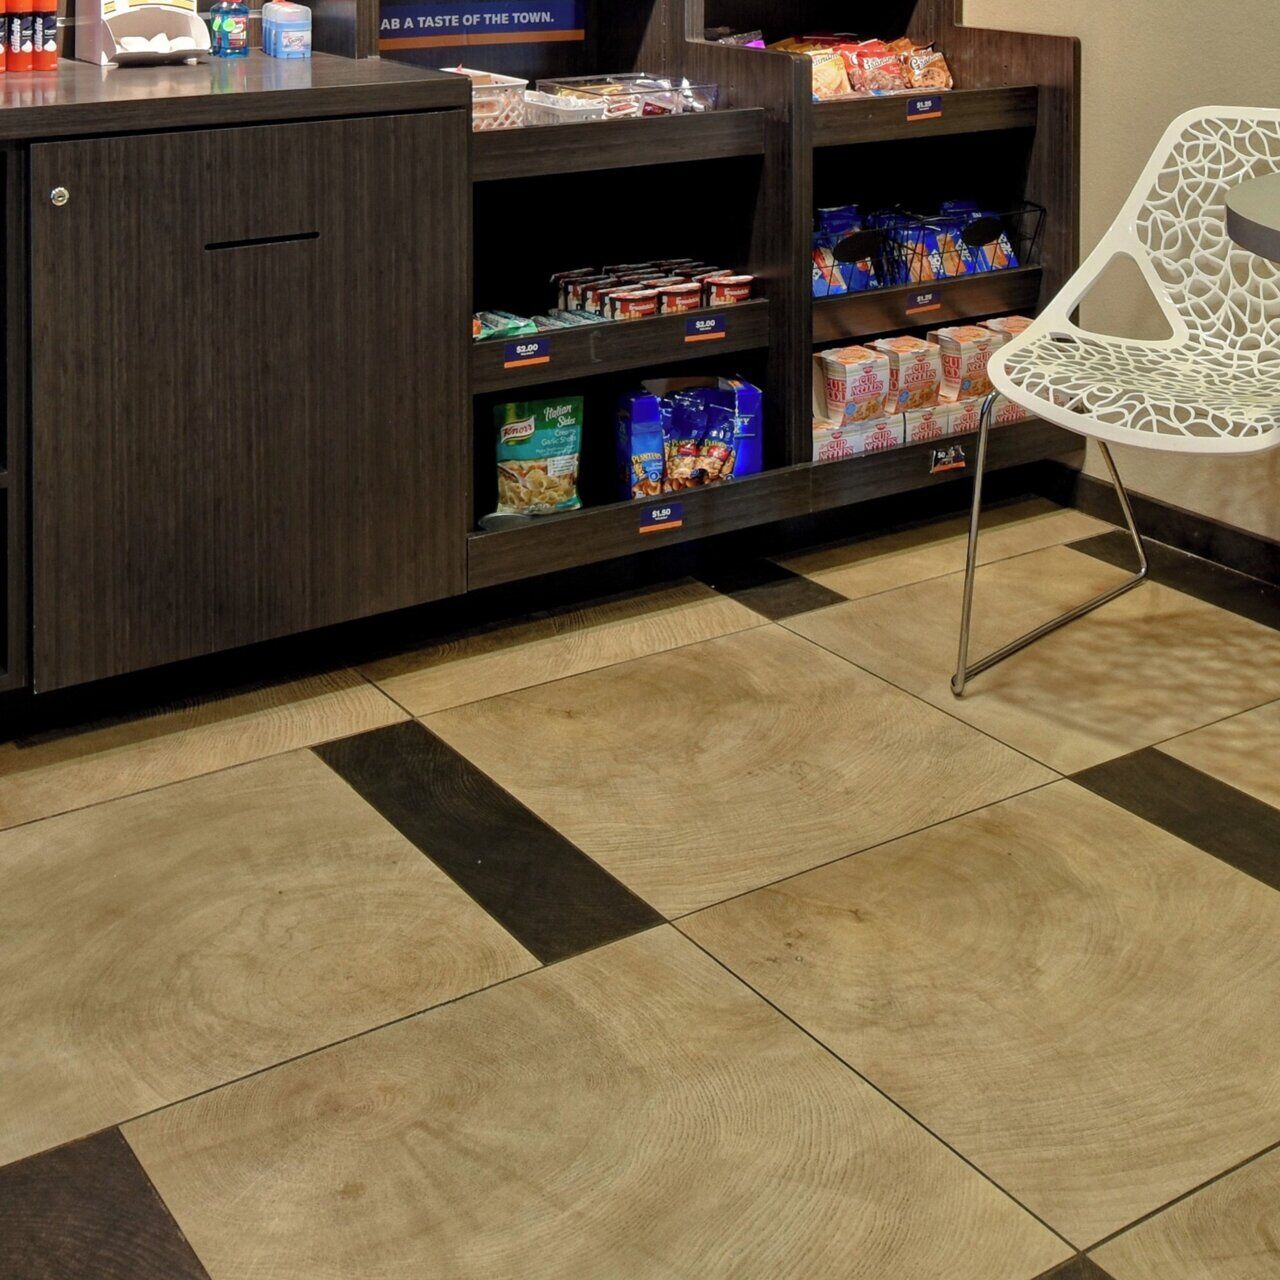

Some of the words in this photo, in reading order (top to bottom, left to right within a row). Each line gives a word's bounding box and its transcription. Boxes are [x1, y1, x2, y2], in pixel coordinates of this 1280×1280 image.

[403, 17, 414, 28] A
[417, 14, 459, 28] TASTE
[462, 13, 480, 26] OF
[483, 12, 509, 25] THE
[511, 11, 555, 24] TOWN.
[695, 319, 716, 329] $2.00
[516, 343, 538, 353] $2.00
[912, 362, 931, 372] CUP
[860, 373, 878, 383] CUP
[904, 369, 937, 384] NOODLES
[850, 380, 884, 397] NOODLES
[543, 405, 572, 422] Italian
[503, 424, 533, 437] Knorr
[872, 430, 891, 441] CUP
[828, 439, 848, 450] CUP
[632, 452, 662, 462] PLANTERS
[651, 508, 671, 518] $1.50
